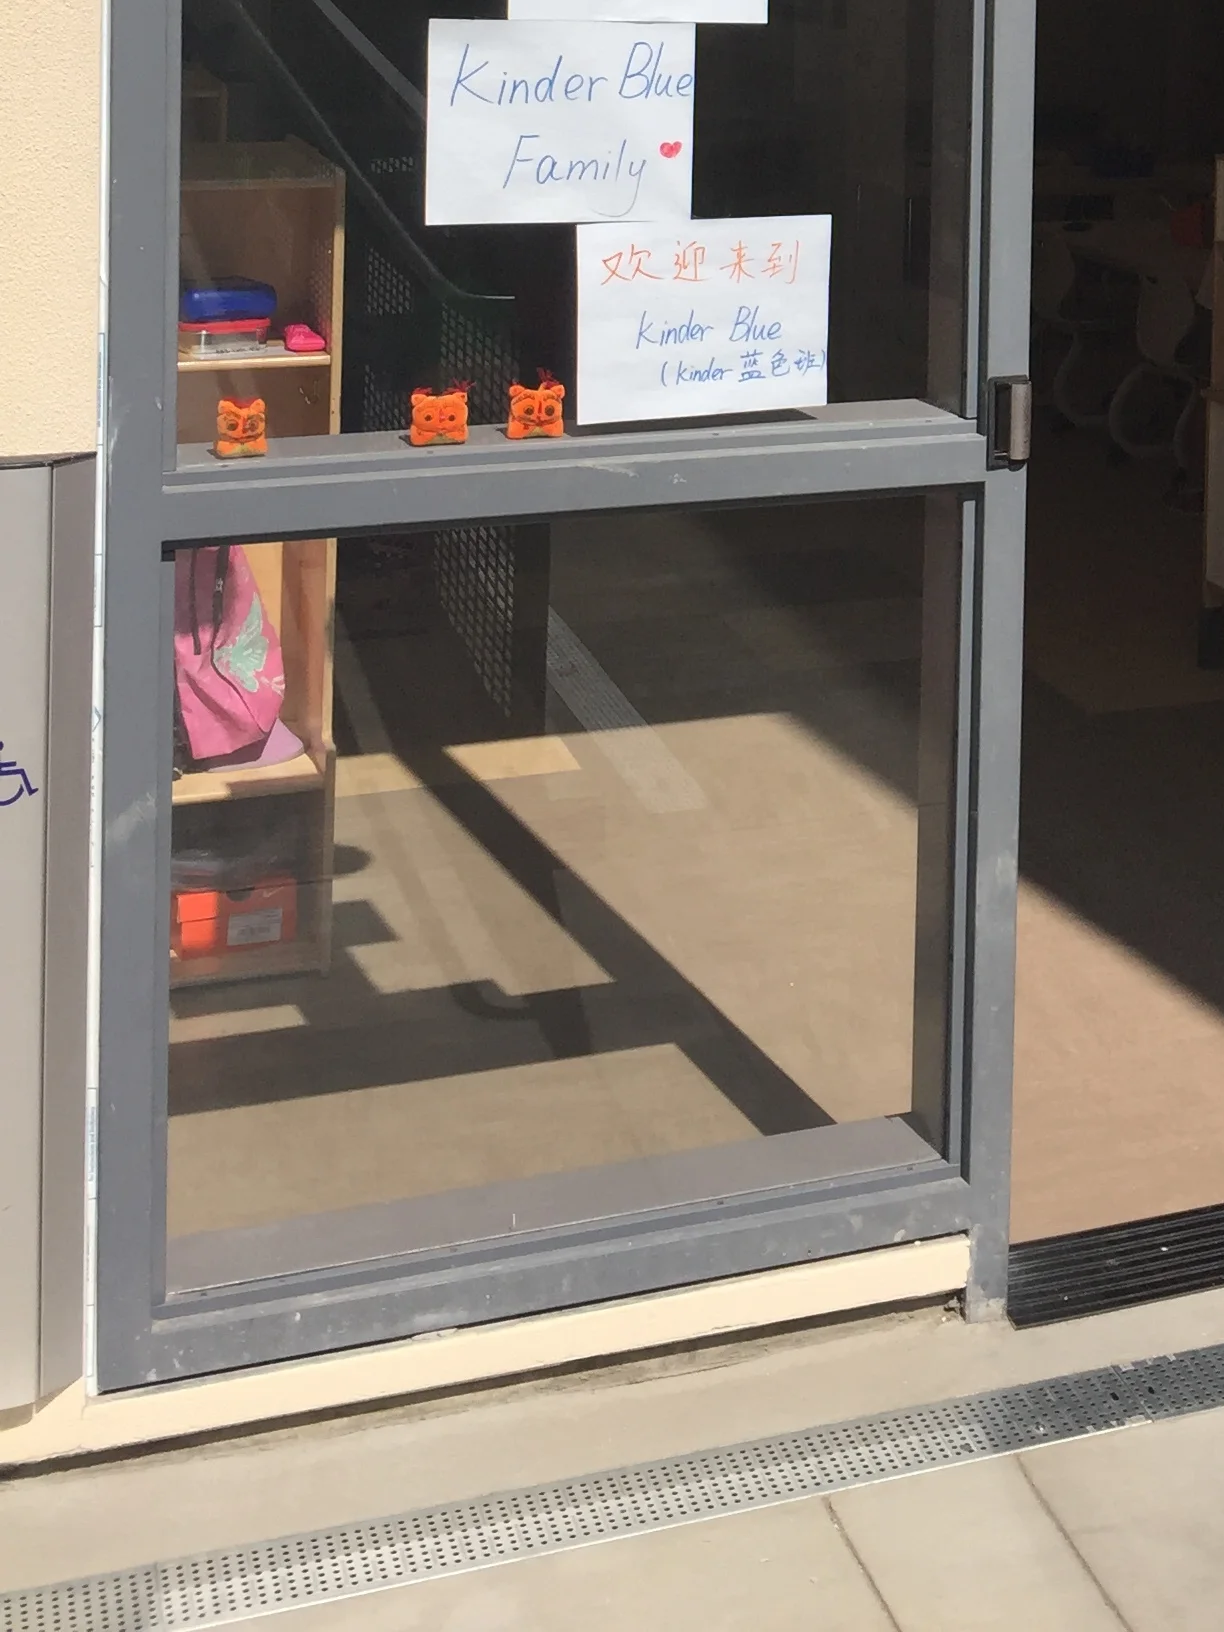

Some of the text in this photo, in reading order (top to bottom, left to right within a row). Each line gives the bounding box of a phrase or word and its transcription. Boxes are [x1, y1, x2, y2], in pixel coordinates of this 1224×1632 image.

[450, 41, 694, 107] Kinder Blue
[502, 134, 647, 218] Family
[600, 239, 800, 286] 欢迎来到
[729, 305, 783, 343] Blue
